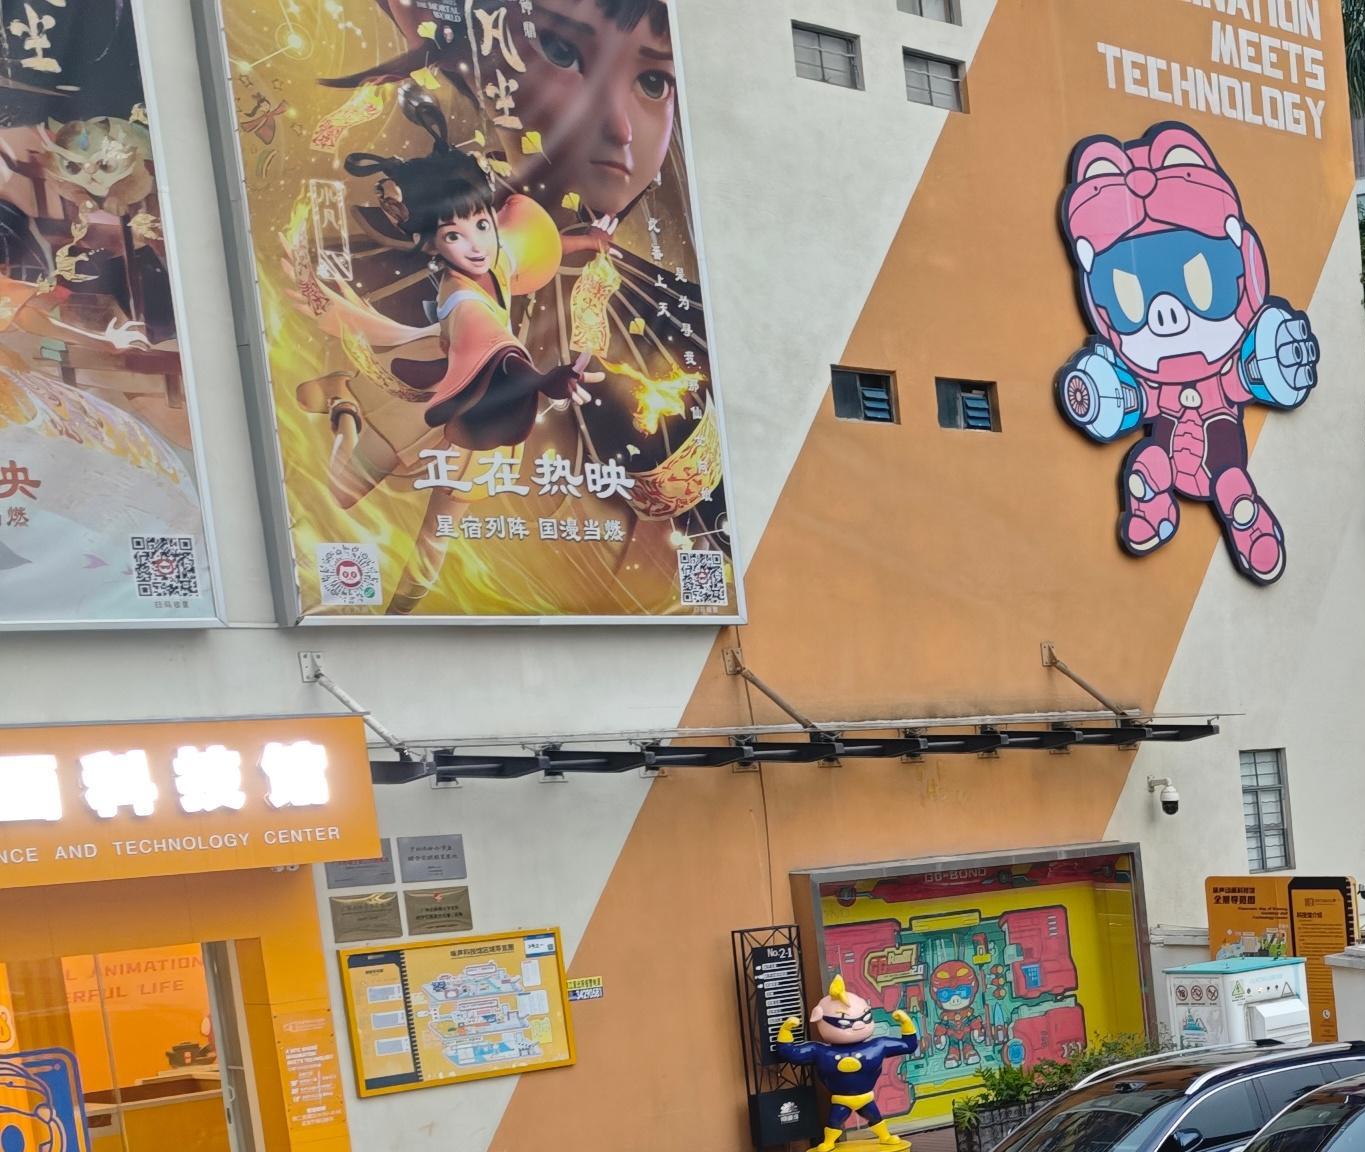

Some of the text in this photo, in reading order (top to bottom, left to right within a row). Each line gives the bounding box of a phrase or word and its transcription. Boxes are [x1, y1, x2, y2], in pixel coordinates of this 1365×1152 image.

[1211, 20, 1326, 91] MEETS
[1097, 41, 1325, 140] TECHNOLOGY
[414, 448, 637, 500] 正在热映
[435, 514, 627, 542] 星宿列阵 国漫当燃
[55, 844, 98, 860] AND
[112, 832, 250, 857] TECHNOLOGY
[263, 827, 341, 846] CENTER
[139, 979, 185, 996] LIFE
